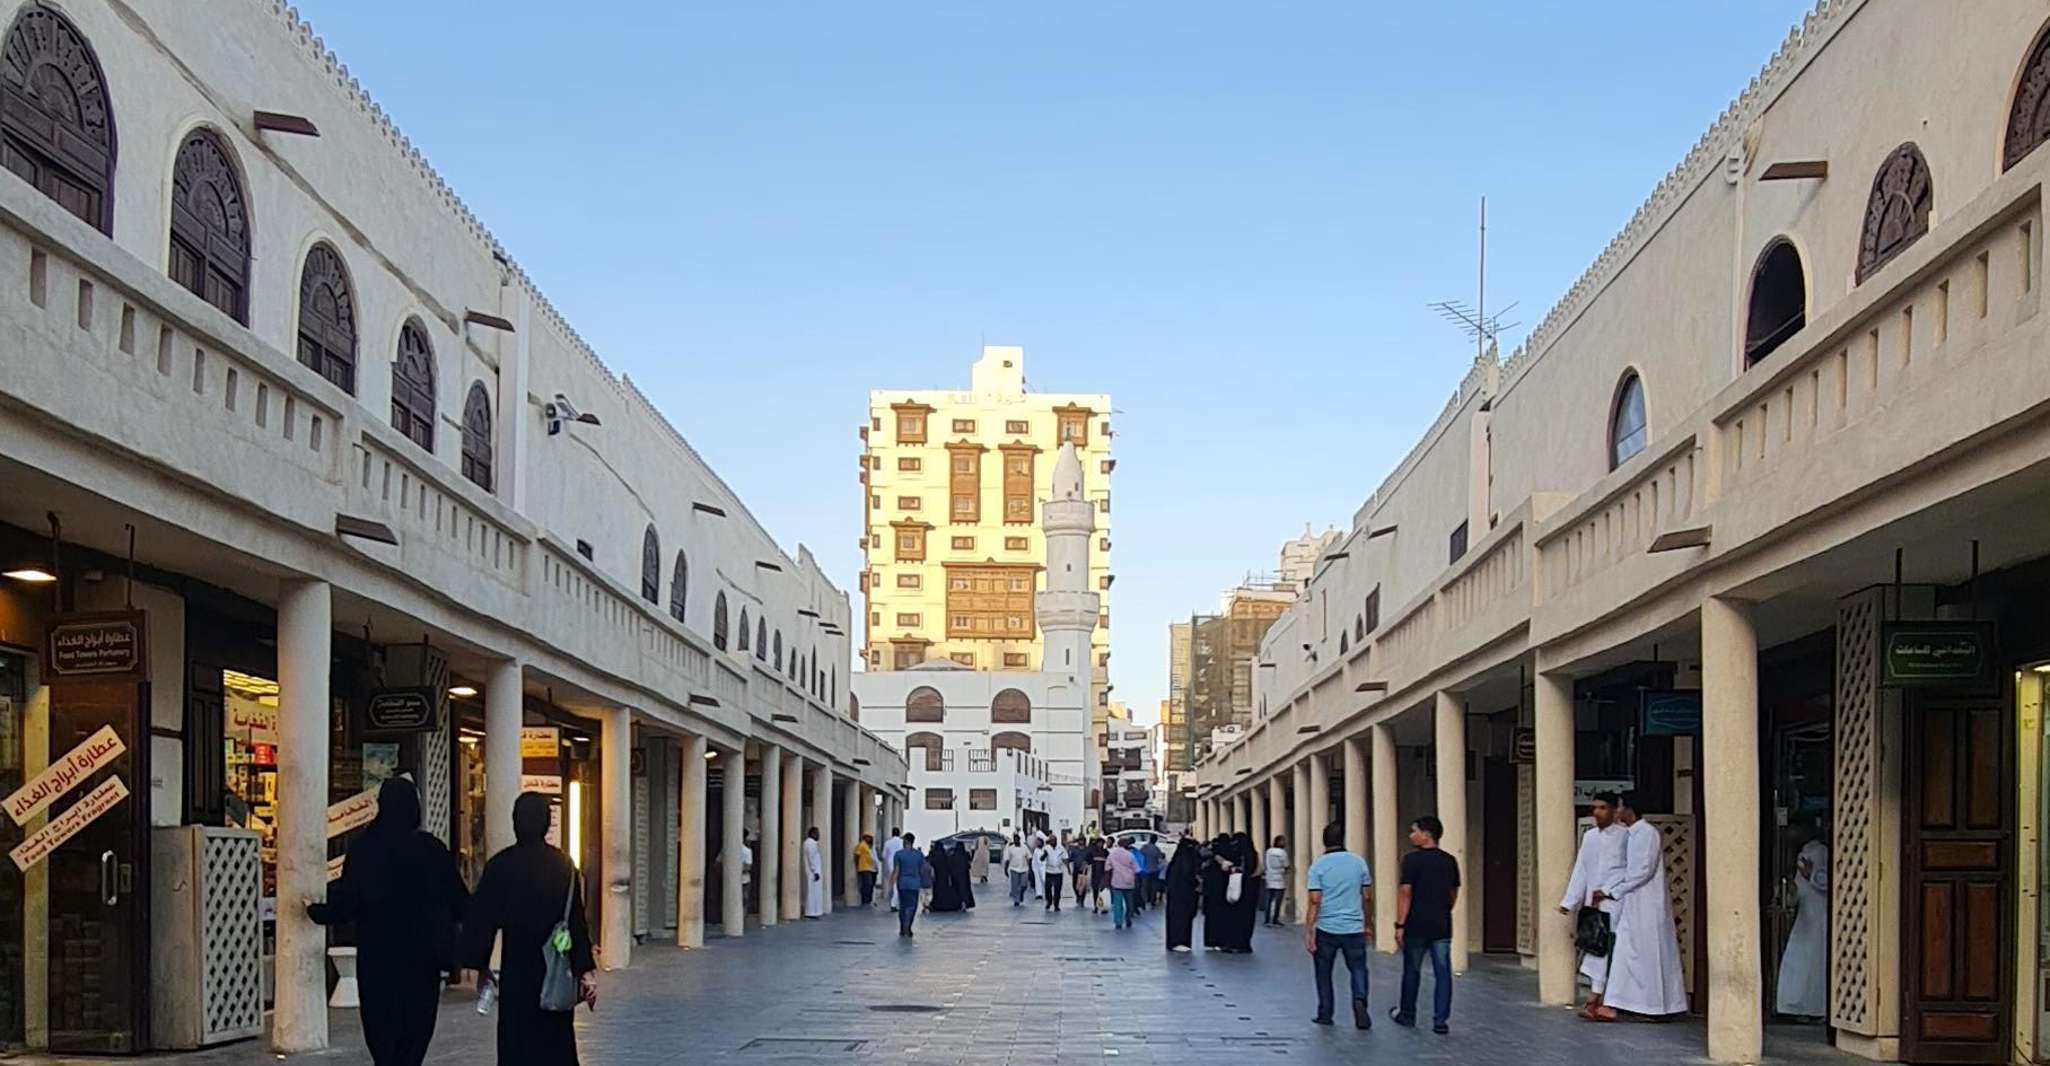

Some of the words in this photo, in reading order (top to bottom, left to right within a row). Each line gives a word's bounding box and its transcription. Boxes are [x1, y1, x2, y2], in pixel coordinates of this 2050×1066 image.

[78, 737, 118, 769] عطارة
[51, 757, 80, 793] أبراج
[15, 781, 52, 817] الغذاء
[82, 783, 116, 809] عطارة
